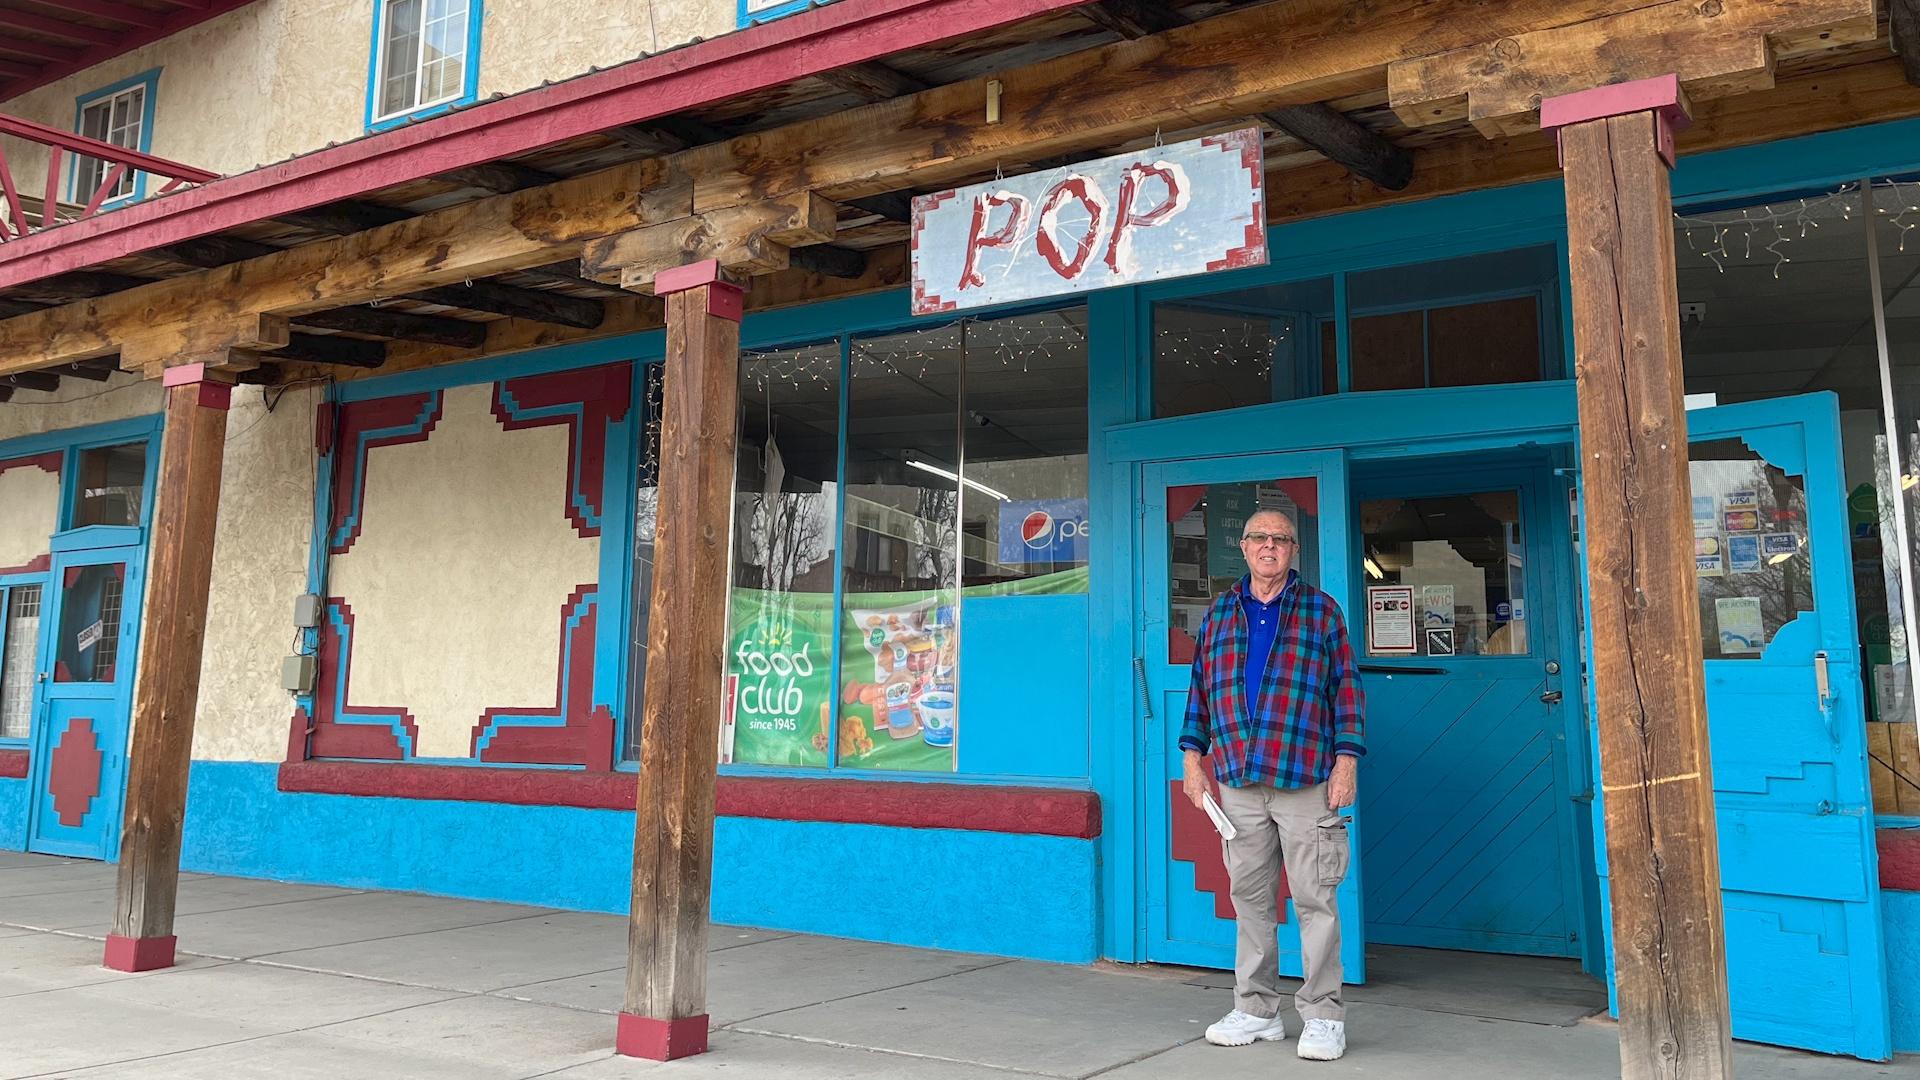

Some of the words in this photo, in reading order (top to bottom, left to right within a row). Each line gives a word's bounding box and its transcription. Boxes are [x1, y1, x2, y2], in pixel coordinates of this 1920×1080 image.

[957, 160, 1190, 291] POP
[1729, 496, 1750, 505] VISA
[1766, 545, 1796, 554] Electron
[1429, 632, 1452, 653] WARNING
[736, 640, 813, 676] food
[741, 676, 803, 715] club
[749, 719, 773, 730] since
[774, 718, 797, 731] 1945
